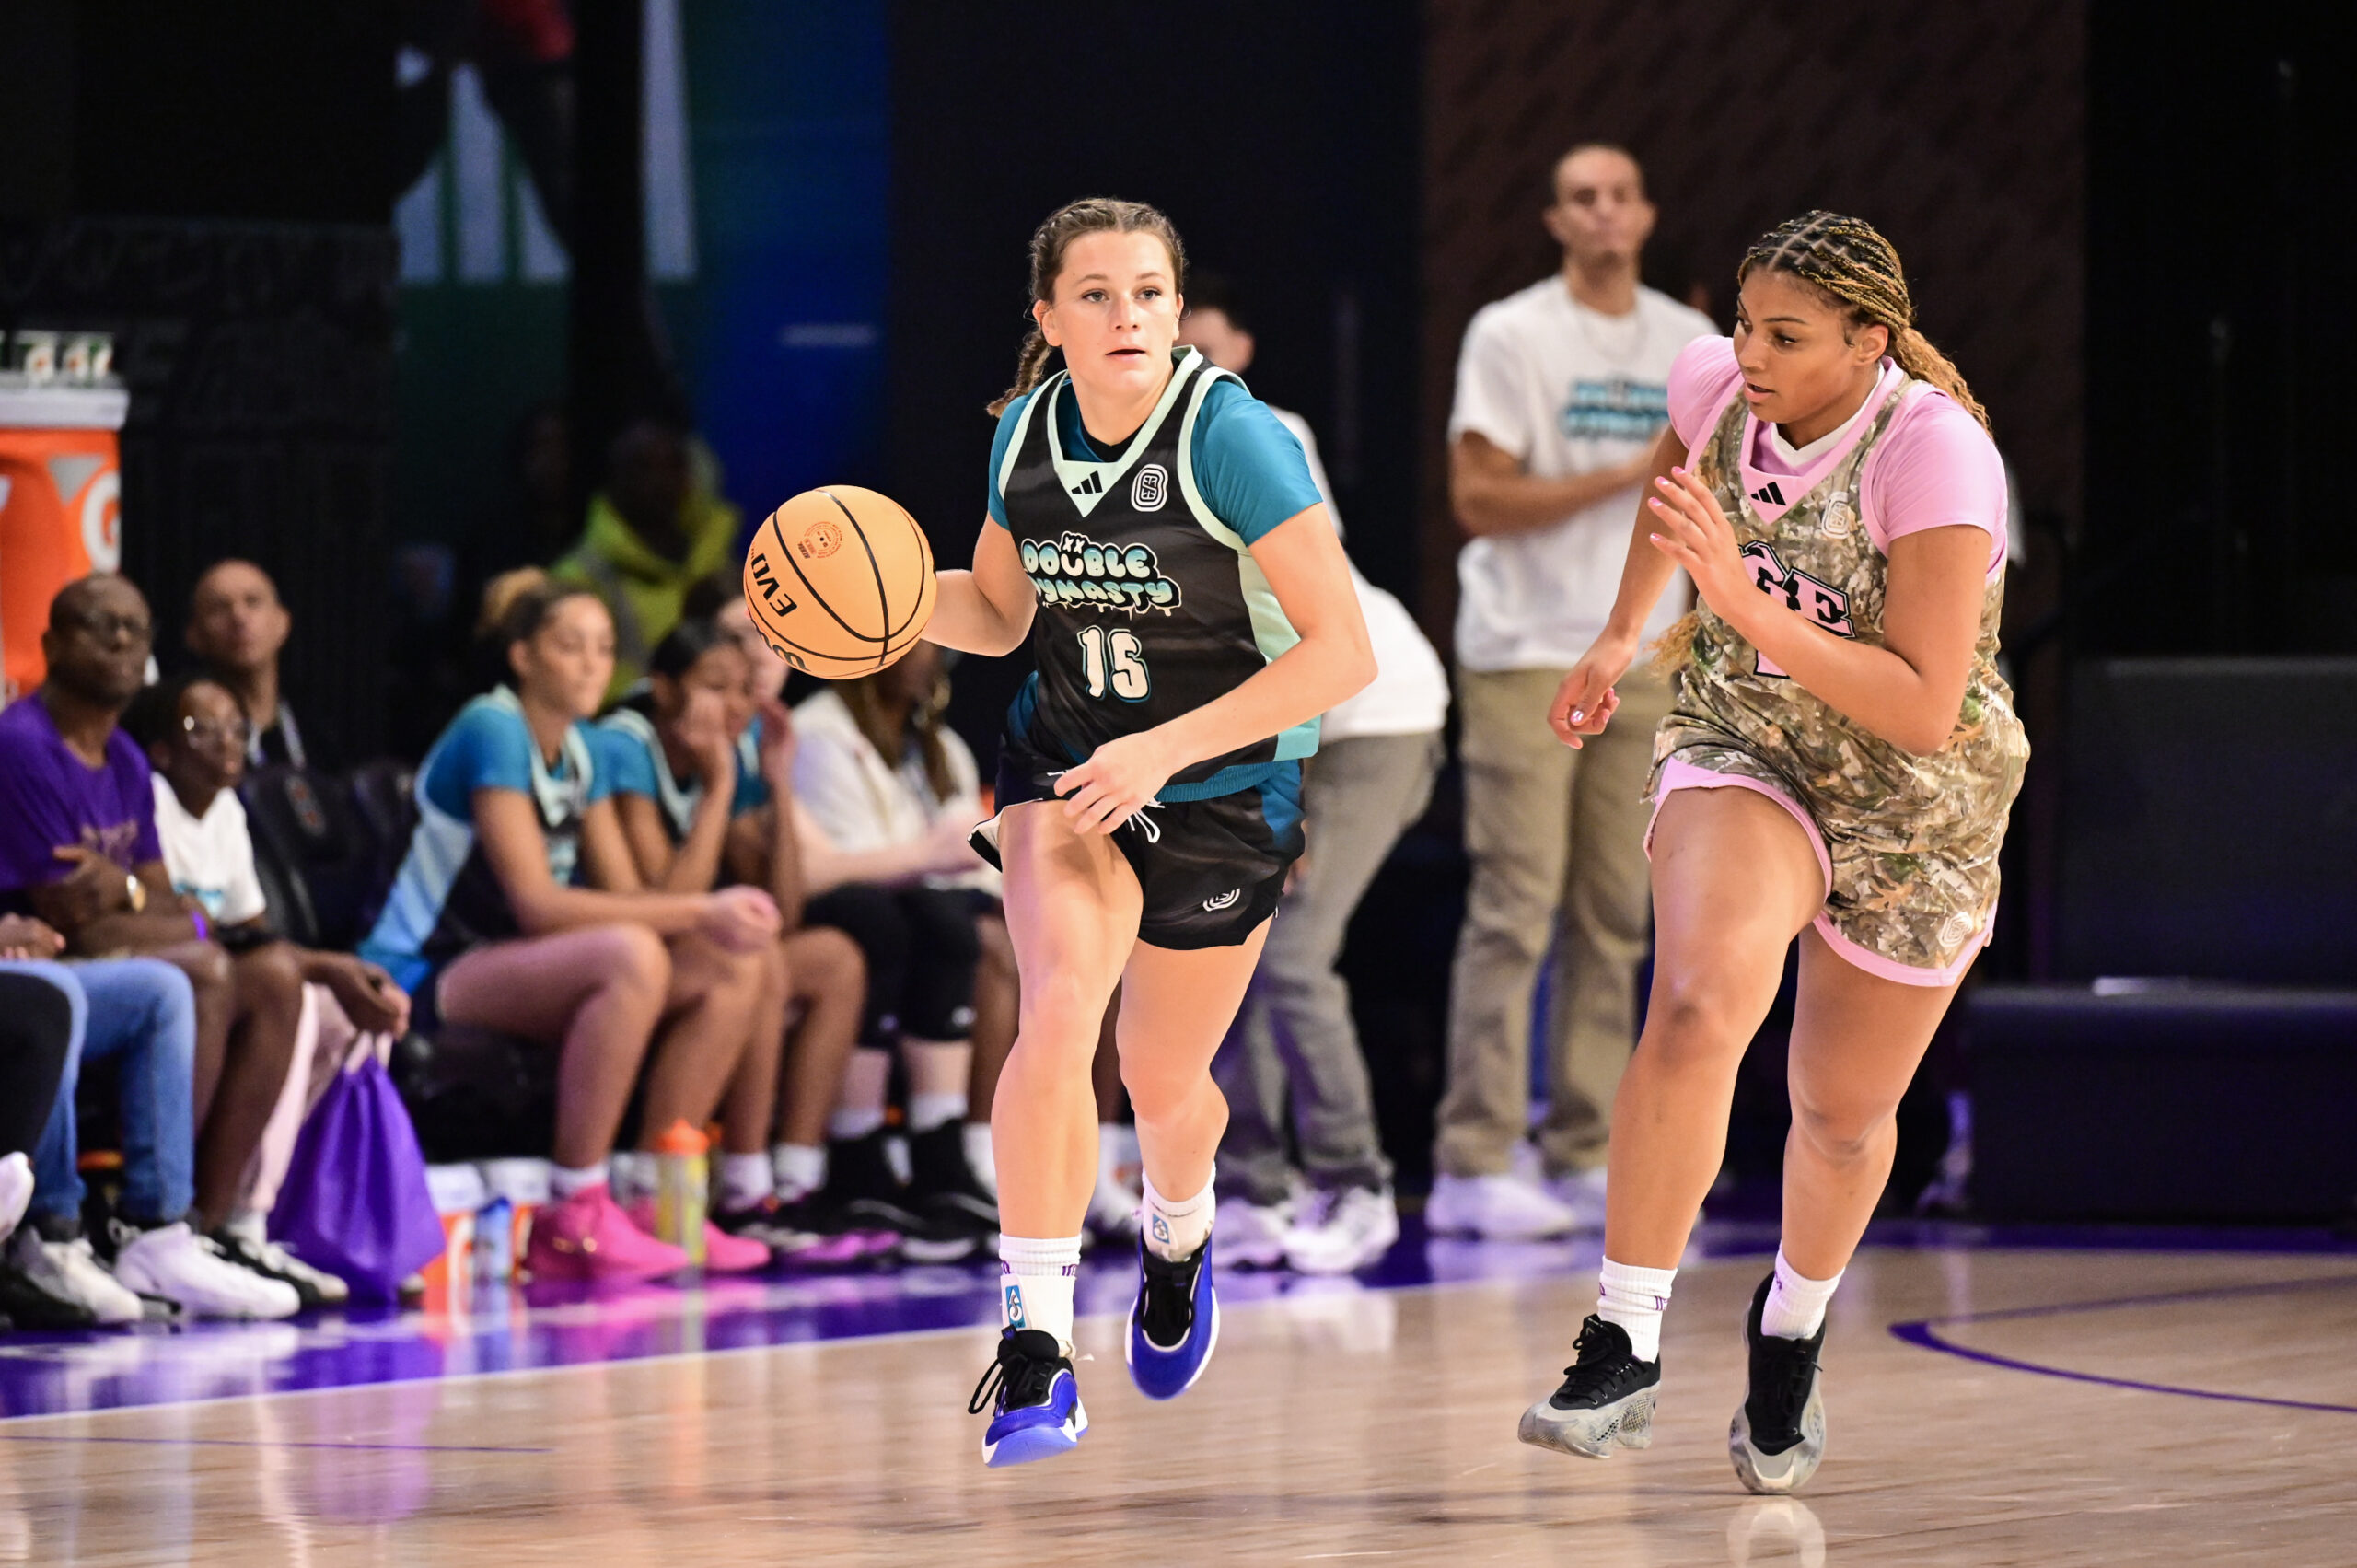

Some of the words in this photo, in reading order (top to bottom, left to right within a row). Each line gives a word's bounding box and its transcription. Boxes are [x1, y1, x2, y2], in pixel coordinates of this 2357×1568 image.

[751, 553, 797, 617] EVO
[1021, 540, 1153, 580] DOUBLE
[1028, 576, 1174, 608] YNASTY
[1738, 540, 1856, 638] GE
[1077, 625, 1151, 703] 15
